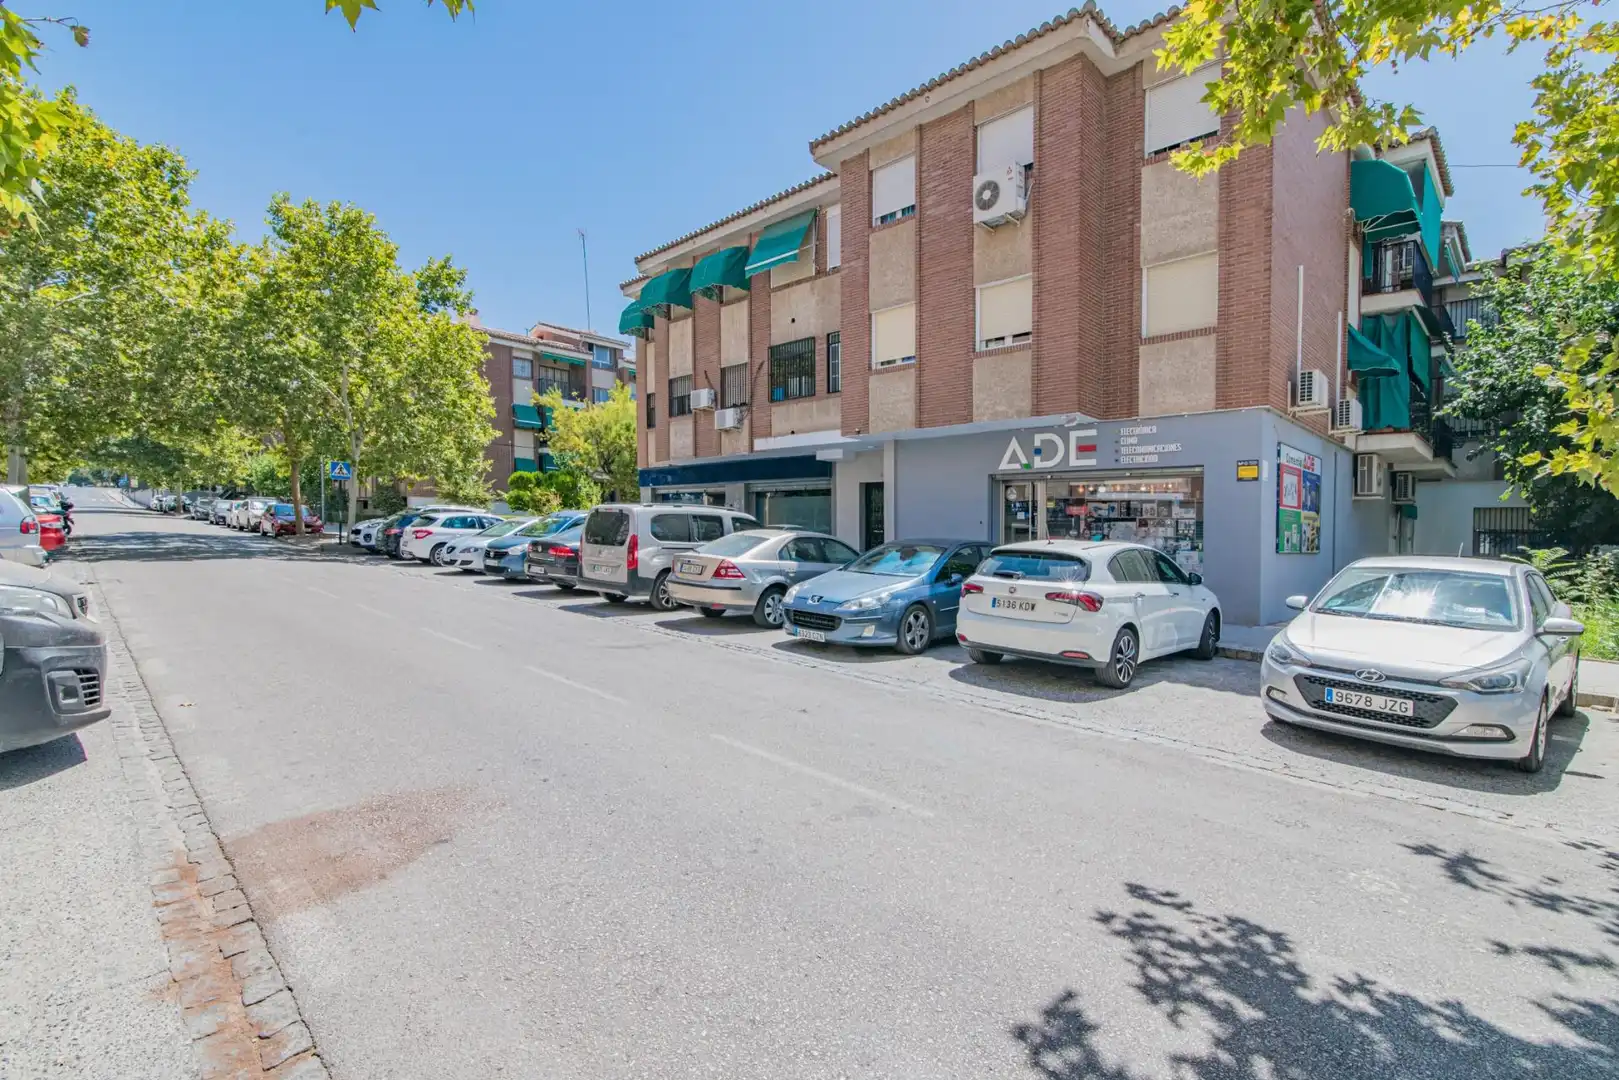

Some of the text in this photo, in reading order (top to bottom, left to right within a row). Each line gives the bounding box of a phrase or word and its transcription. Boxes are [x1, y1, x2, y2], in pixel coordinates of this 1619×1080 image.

[998, 429, 1098, 470] ADE
[996, 599, 1017, 609] 5136
[1335, 691, 1409, 713] 9678 JZG
